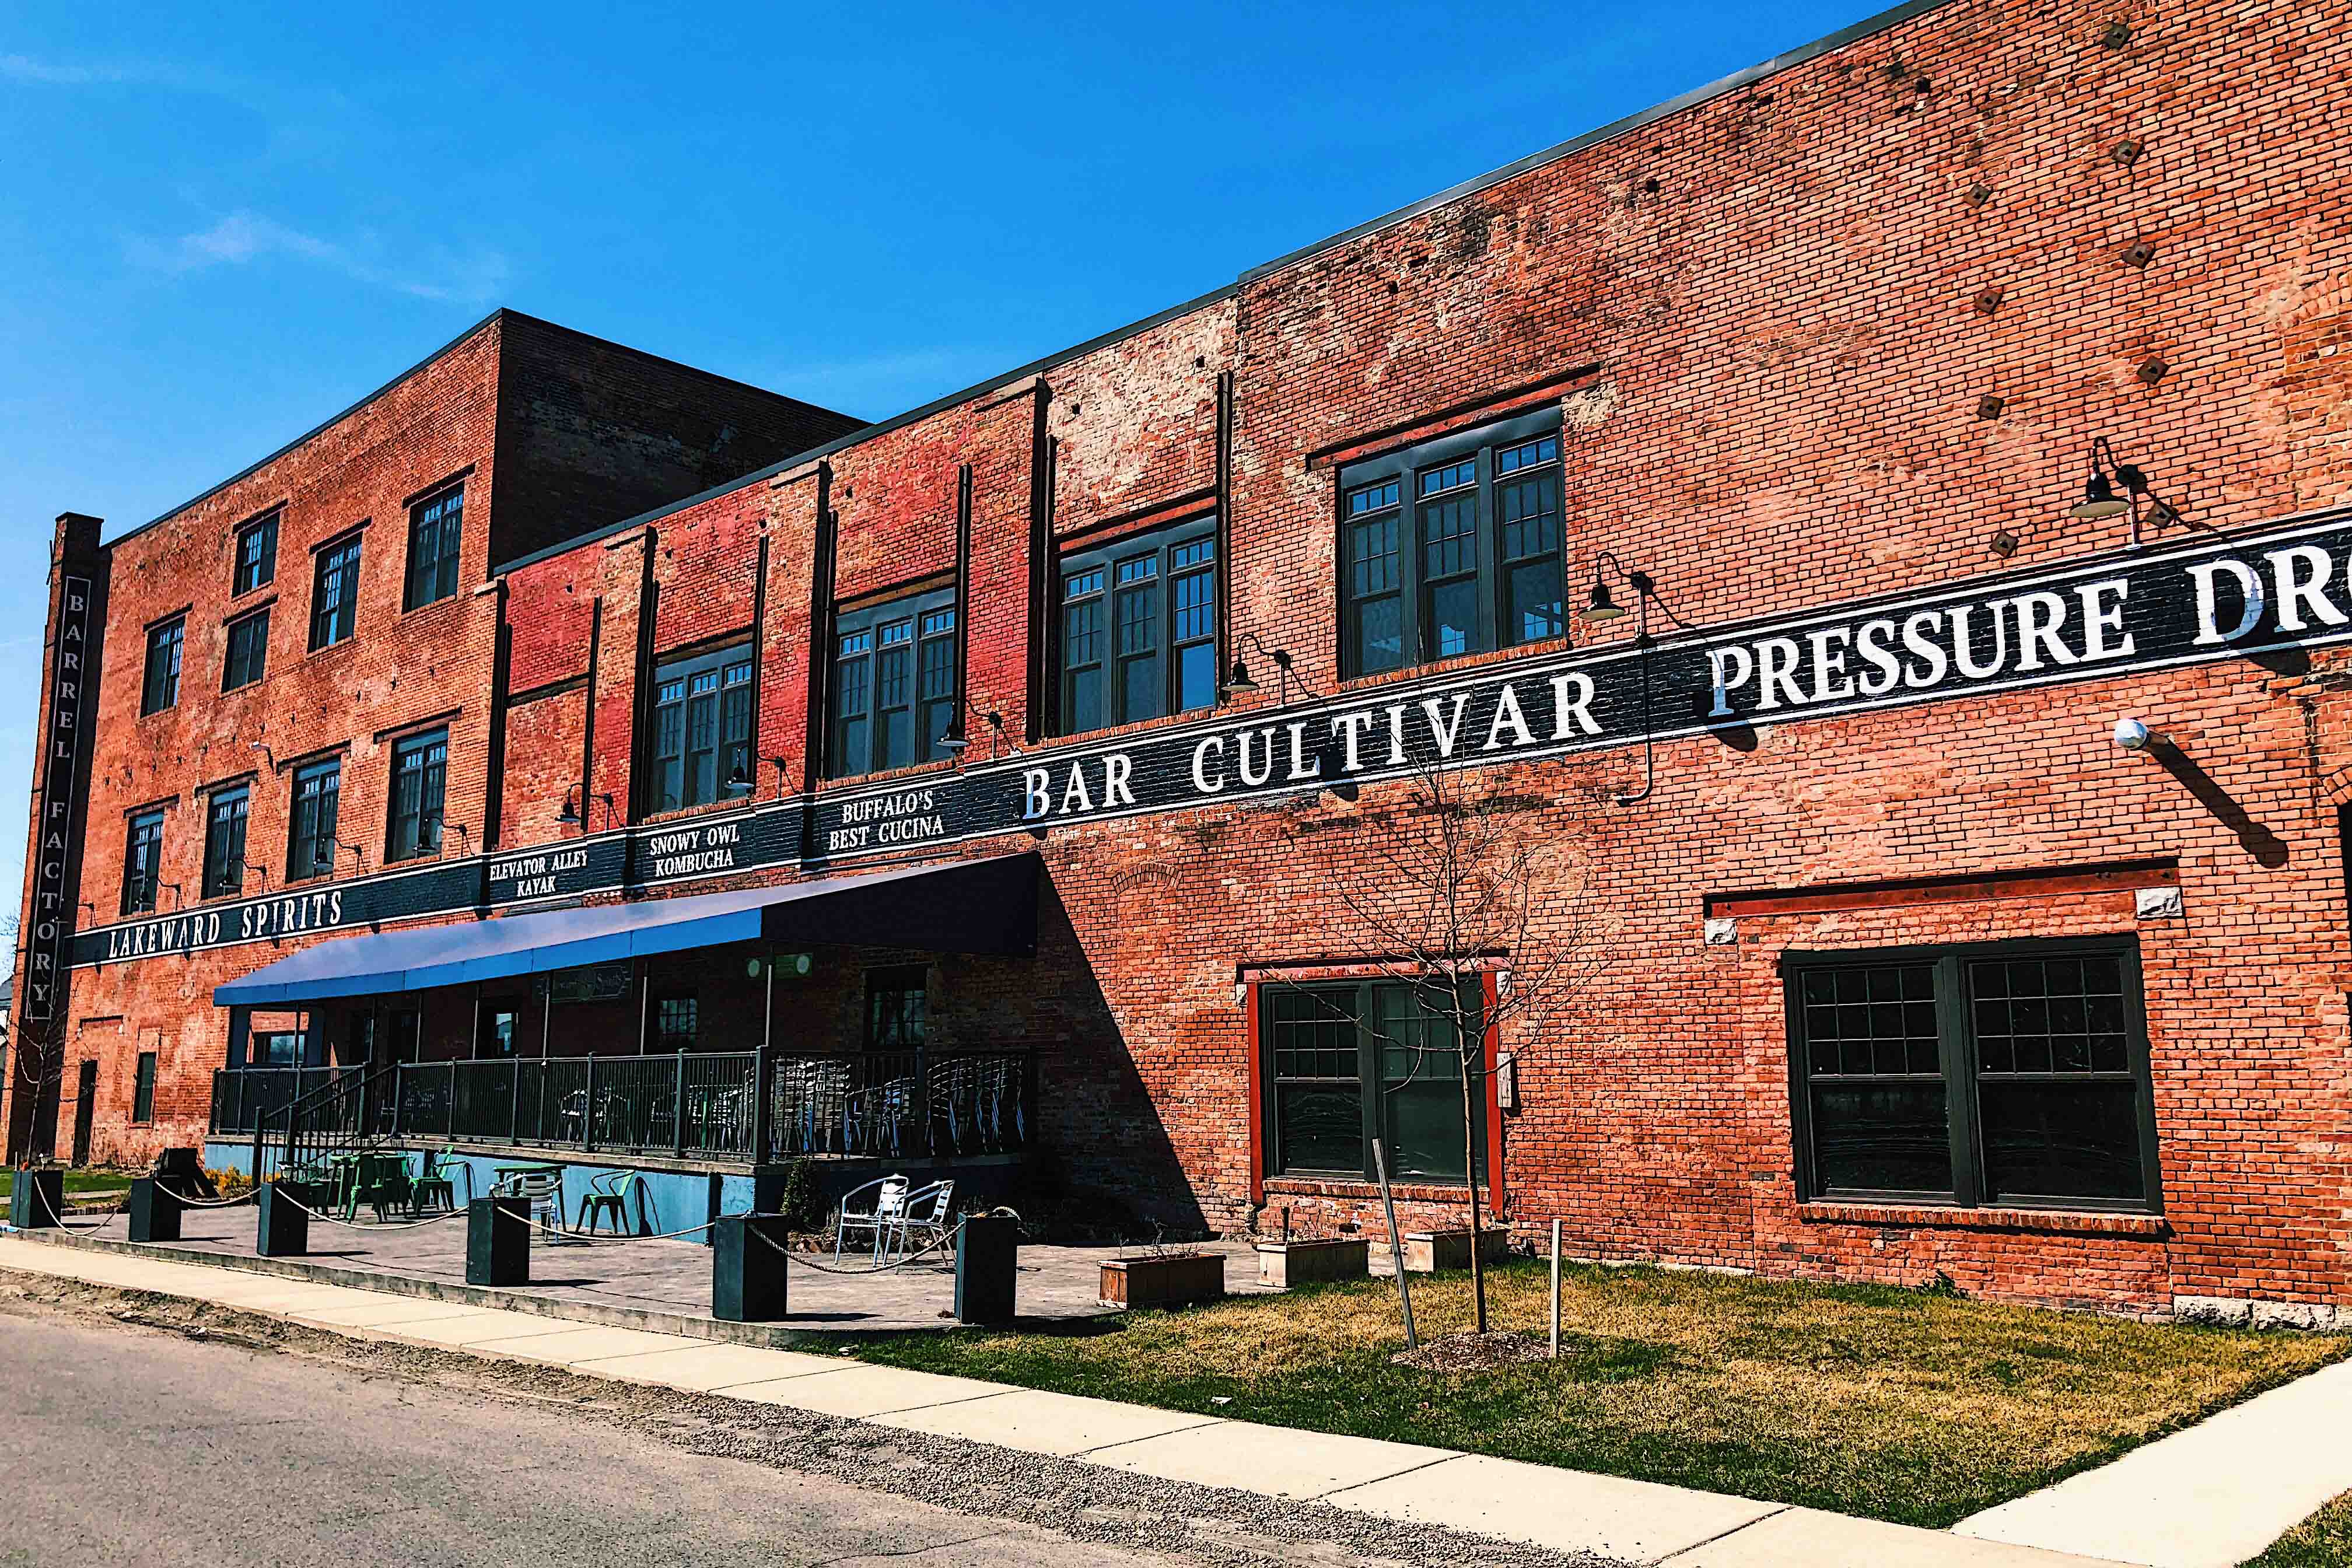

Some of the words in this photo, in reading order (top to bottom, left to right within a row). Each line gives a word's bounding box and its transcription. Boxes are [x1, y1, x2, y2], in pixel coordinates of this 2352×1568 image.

[1706, 579, 2135, 717] PRESSURE
[2185, 545, 2352, 645] DR
[56, 594, 83, 758] BARREL
[1023, 754, 1136, 820] BAR
[1192, 672, 1604, 793] CULTIVAR
[842, 790, 933, 824] BUFFALO'S
[650, 832, 699, 855] SNOWY
[708, 824, 740, 846] OWL
[829, 826, 870, 850] BEST
[878, 815, 944, 842] CUCINA
[489, 856, 545, 881] ELEVATOR
[551, 850, 587, 872] ALLEY
[654, 849, 734, 877] KOMBUCHA
[33, 802, 64, 1001] FACTORY
[517, 876, 555, 897] KAYAK
[108, 912, 220, 958] LAKEWARD
[242, 891, 341, 937] SPIRITS
